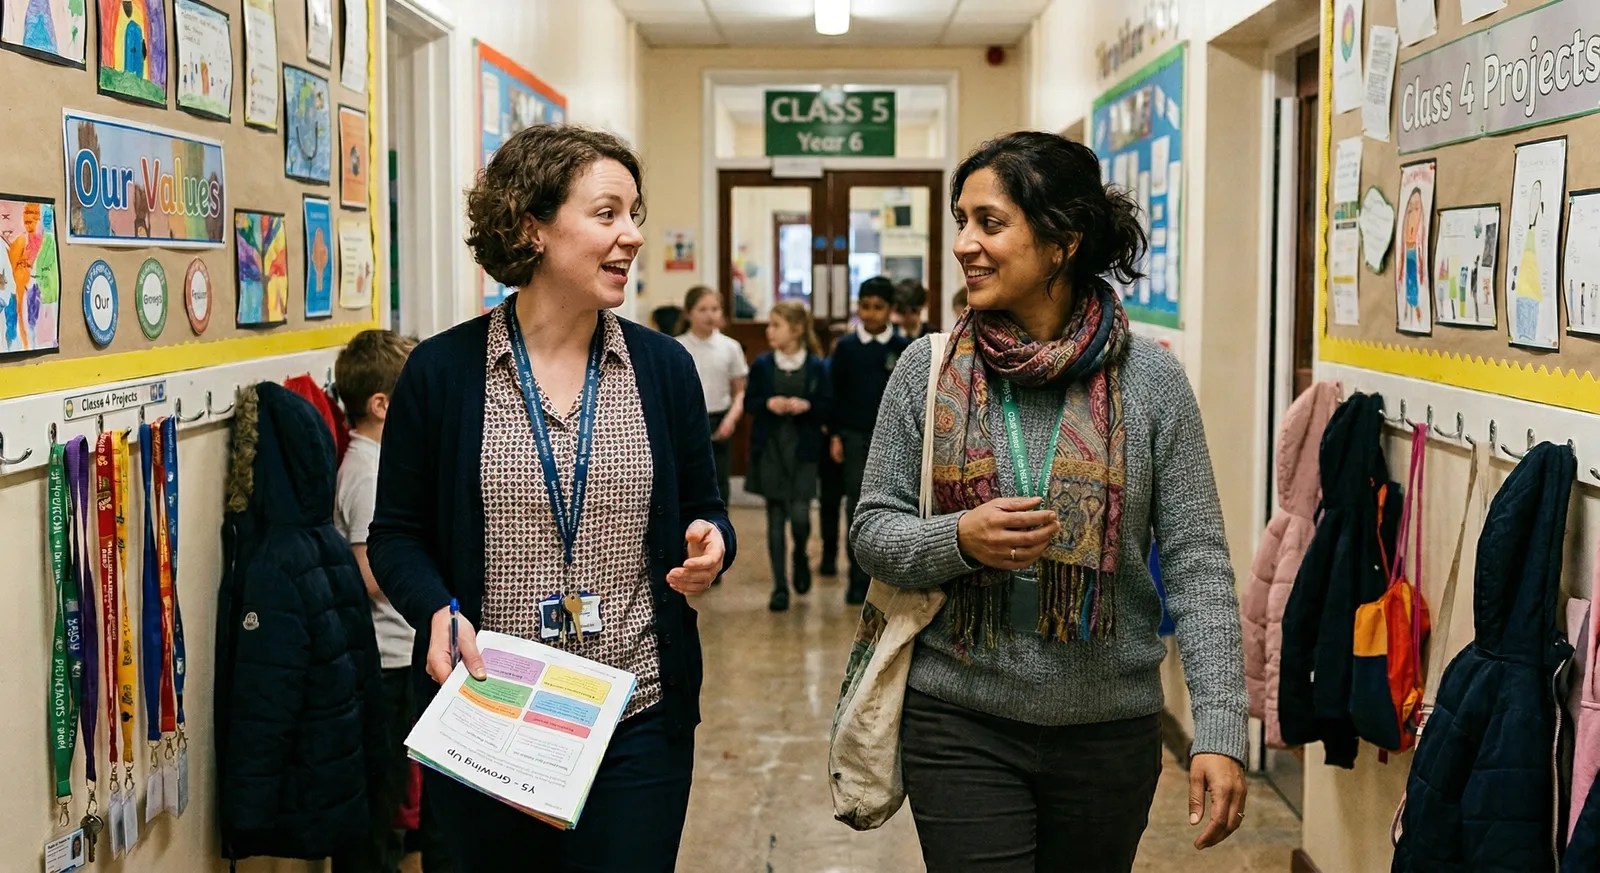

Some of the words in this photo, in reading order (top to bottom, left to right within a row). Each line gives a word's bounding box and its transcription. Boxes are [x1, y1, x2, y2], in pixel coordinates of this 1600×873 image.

[1401, 75, 1453, 133] Class
[1459, 62, 1475, 115] 4
[1483, 28, 1600, 118] Projects
[770, 96, 864, 123] CLASS
[871, 97, 890, 123] 5
[797, 131, 846, 152] Year
[850, 131, 864, 152] 6
[75, 148, 133, 210] Our
[140, 156, 221, 219] Values
[94, 293, 110, 310] Our
[105, 393, 110, 406] 4
[111, 391, 138, 408] Projects
[446, 748, 462, 763] Up
[463, 754, 512, 786] Growing
[521, 782, 536, 795] Y5
